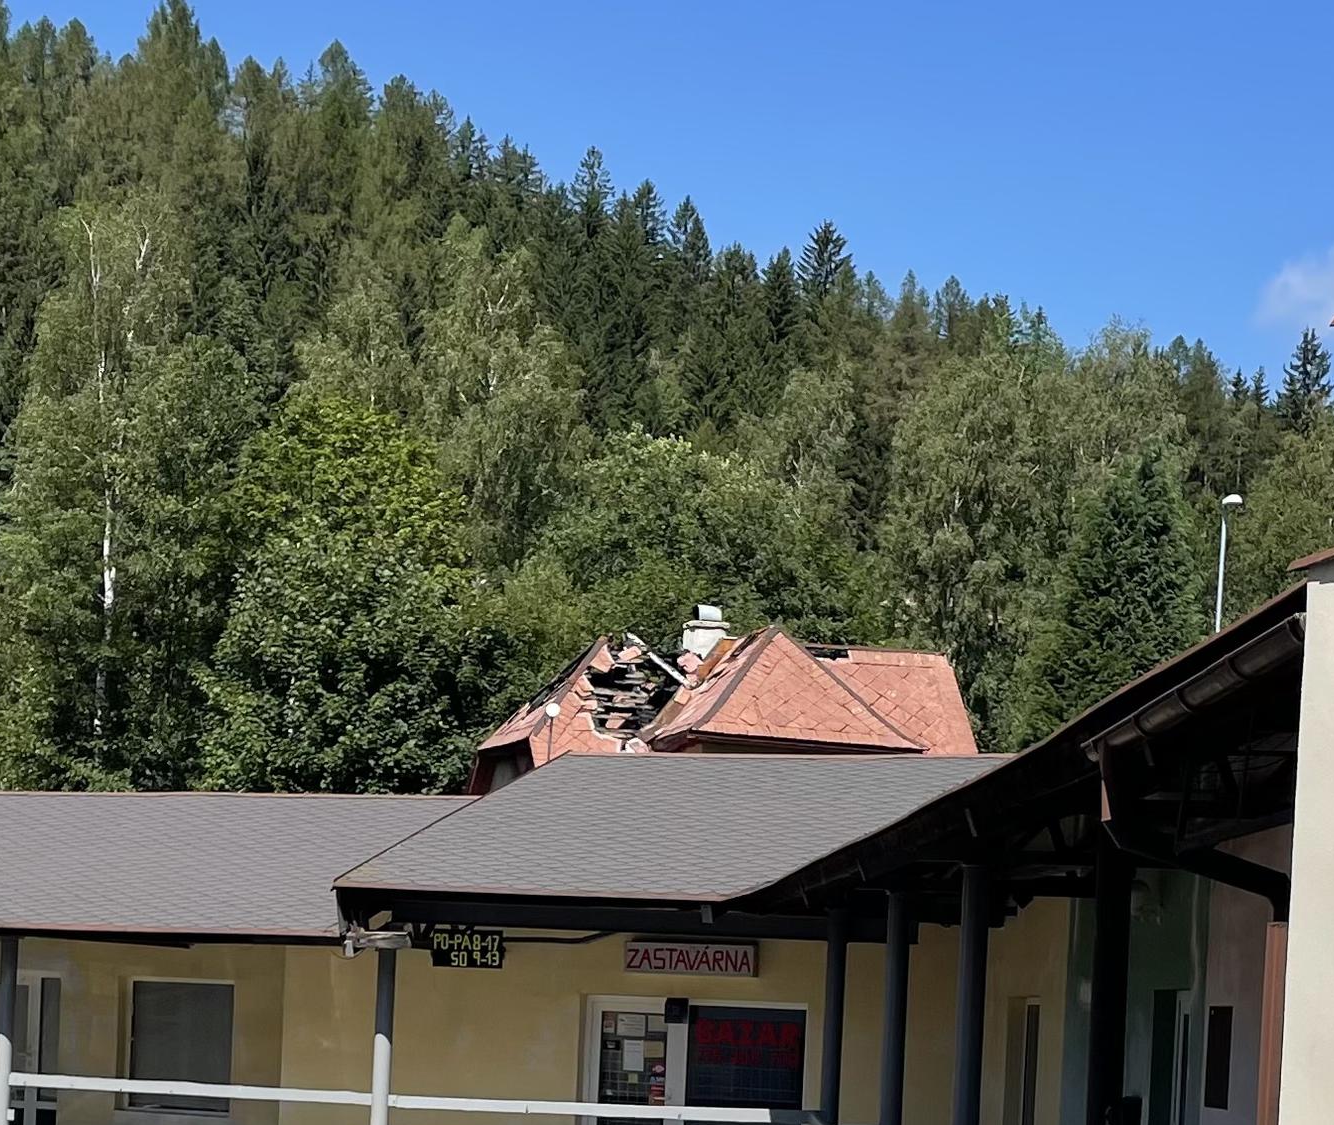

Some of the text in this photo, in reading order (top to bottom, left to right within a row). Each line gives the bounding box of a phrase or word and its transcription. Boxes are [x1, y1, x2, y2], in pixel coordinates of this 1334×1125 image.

[433, 930, 500, 951] PO-PÁ 8-17
[450, 951, 500, 967] SO 9-13
[626, 946, 752, 973] ZASTAVÁRNA
